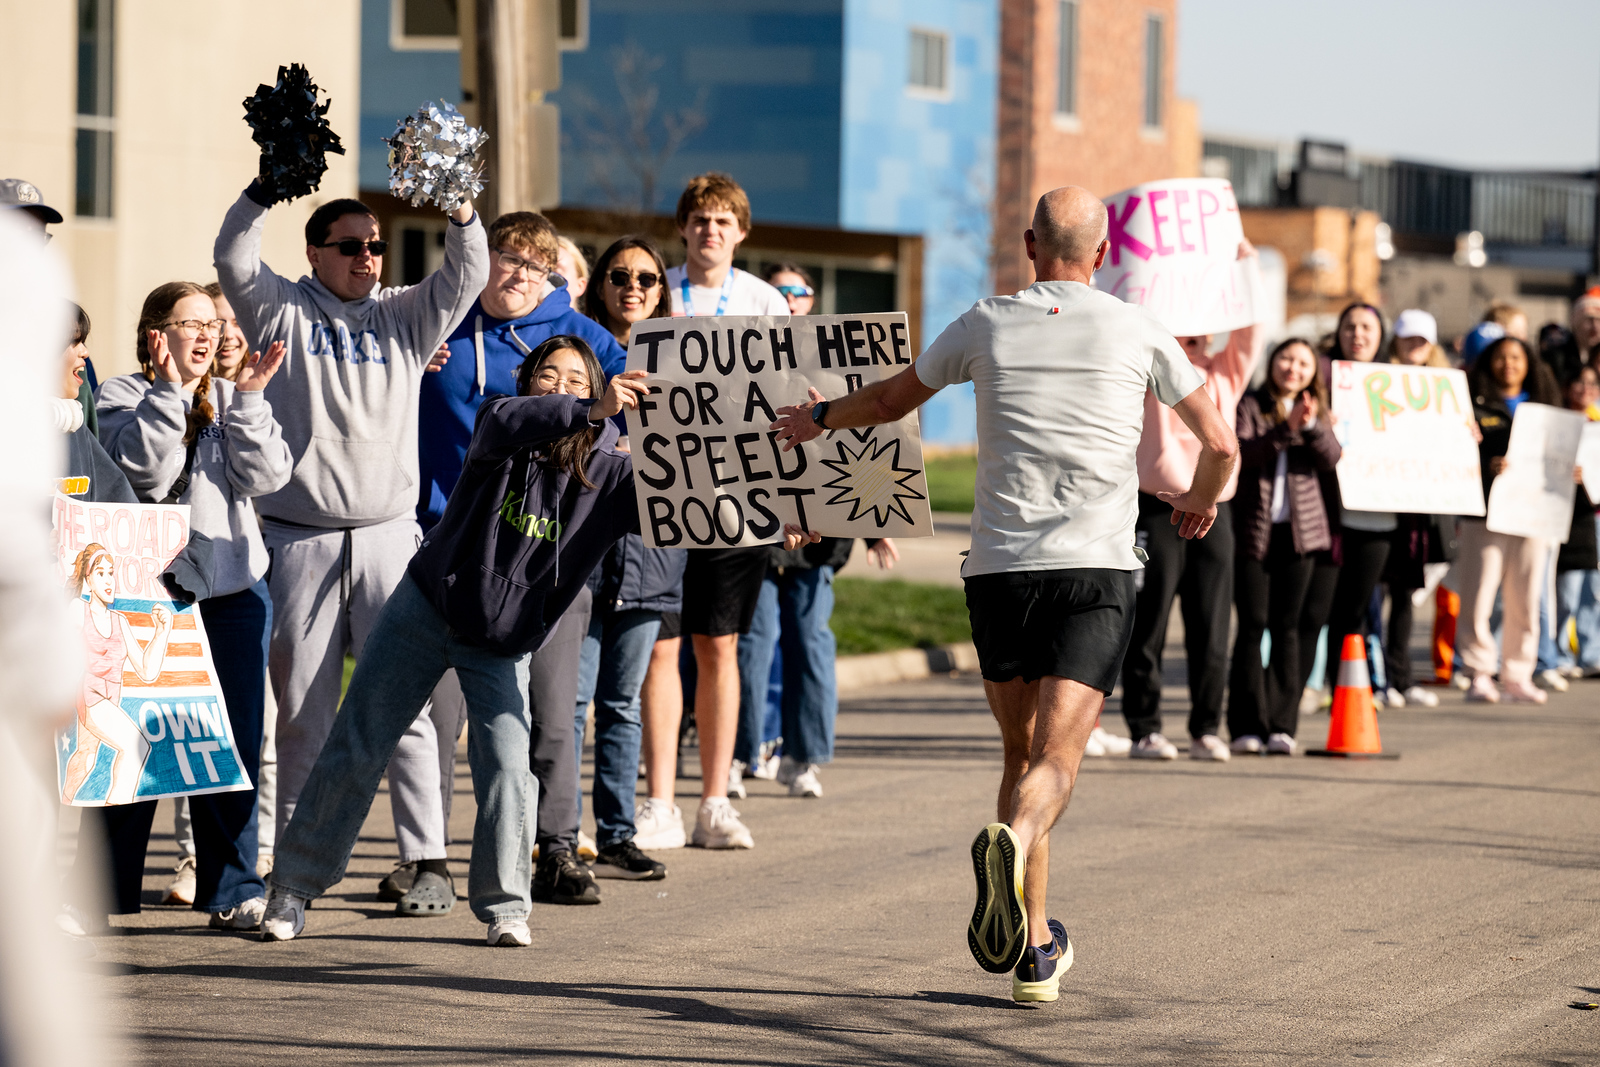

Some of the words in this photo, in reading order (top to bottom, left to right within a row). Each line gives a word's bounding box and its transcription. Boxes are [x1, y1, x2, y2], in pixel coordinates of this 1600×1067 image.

[1107, 189, 1220, 267] KEEP
[307, 322, 387, 364] DRAKE
[635, 327, 797, 376] TOUCH
[816, 320, 911, 369] HERE
[639, 381, 723, 427] FOR
[743, 381, 777, 422] A
[638, 430, 807, 490] SPEED
[56, 499, 87, 551] THE
[89, 507, 187, 559] ROAD
[647, 487, 816, 547] BOOST
[113, 556, 176, 600] YOR
[139, 701, 225, 743] OWN
[173, 740, 221, 785] IT
